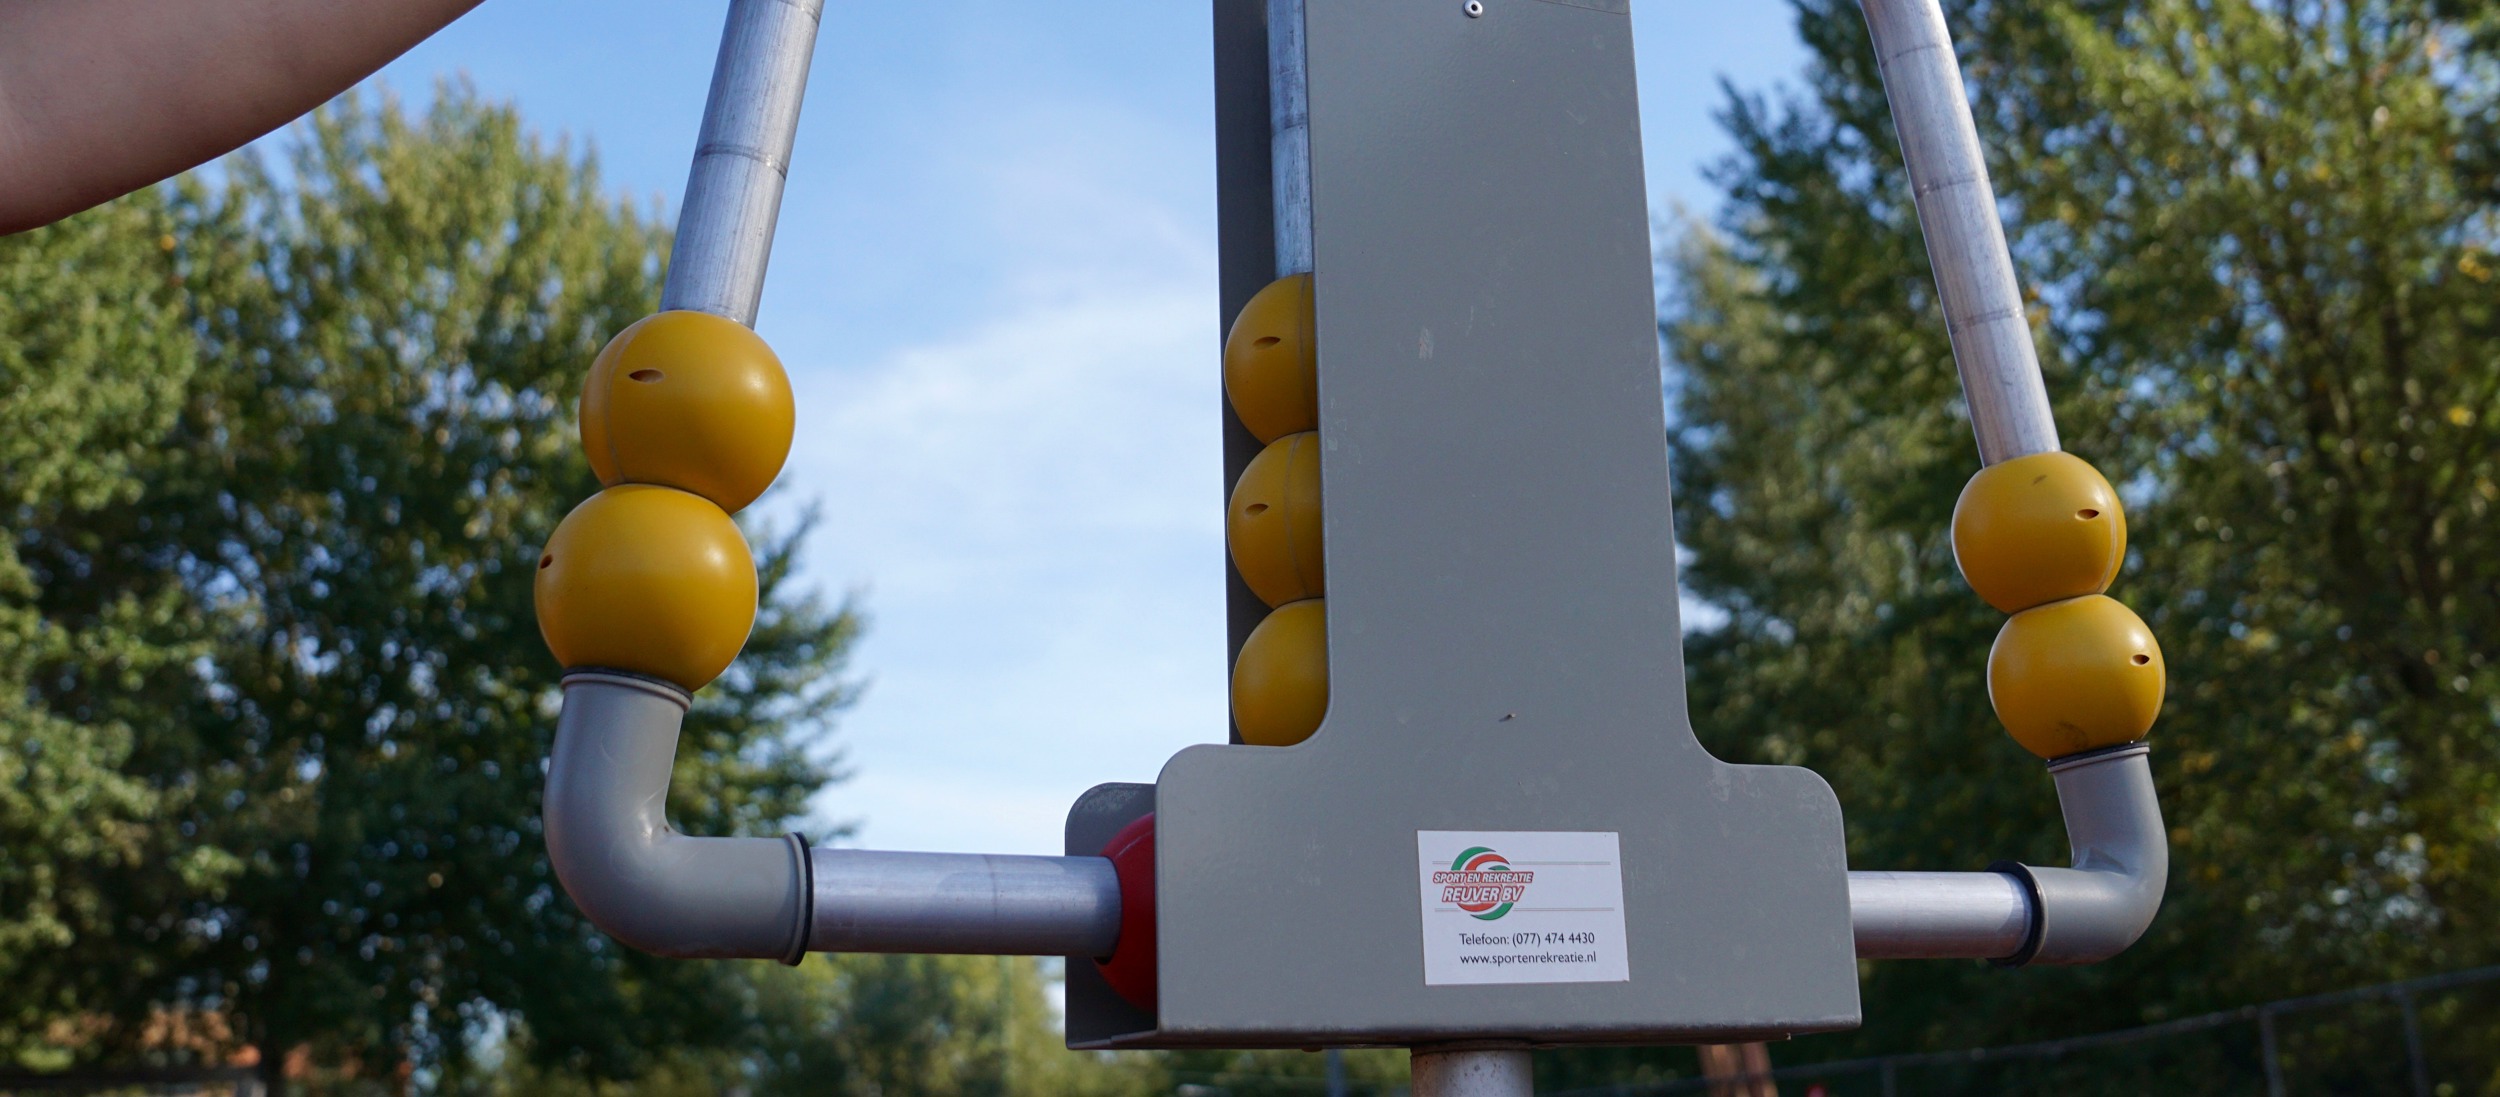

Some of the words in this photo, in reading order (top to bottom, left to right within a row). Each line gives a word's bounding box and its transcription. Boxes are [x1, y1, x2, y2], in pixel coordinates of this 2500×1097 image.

[1433, 871, 1465, 883] SPORT
[1466, 871, 1480, 883] EN
[1482, 871, 1534, 883] REKREATIE
[1442, 886, 1500, 902] REUVER
[1501, 886, 1525, 902] BV
[1459, 933, 1510, 945] Telefoon:
[1512, 932, 1541, 947] (077)
[1545, 932, 1565, 944] 474
[1568, 932, 1595, 944] 4430
[1460, 951, 1597, 967] www.sportenrekreatie.nl
